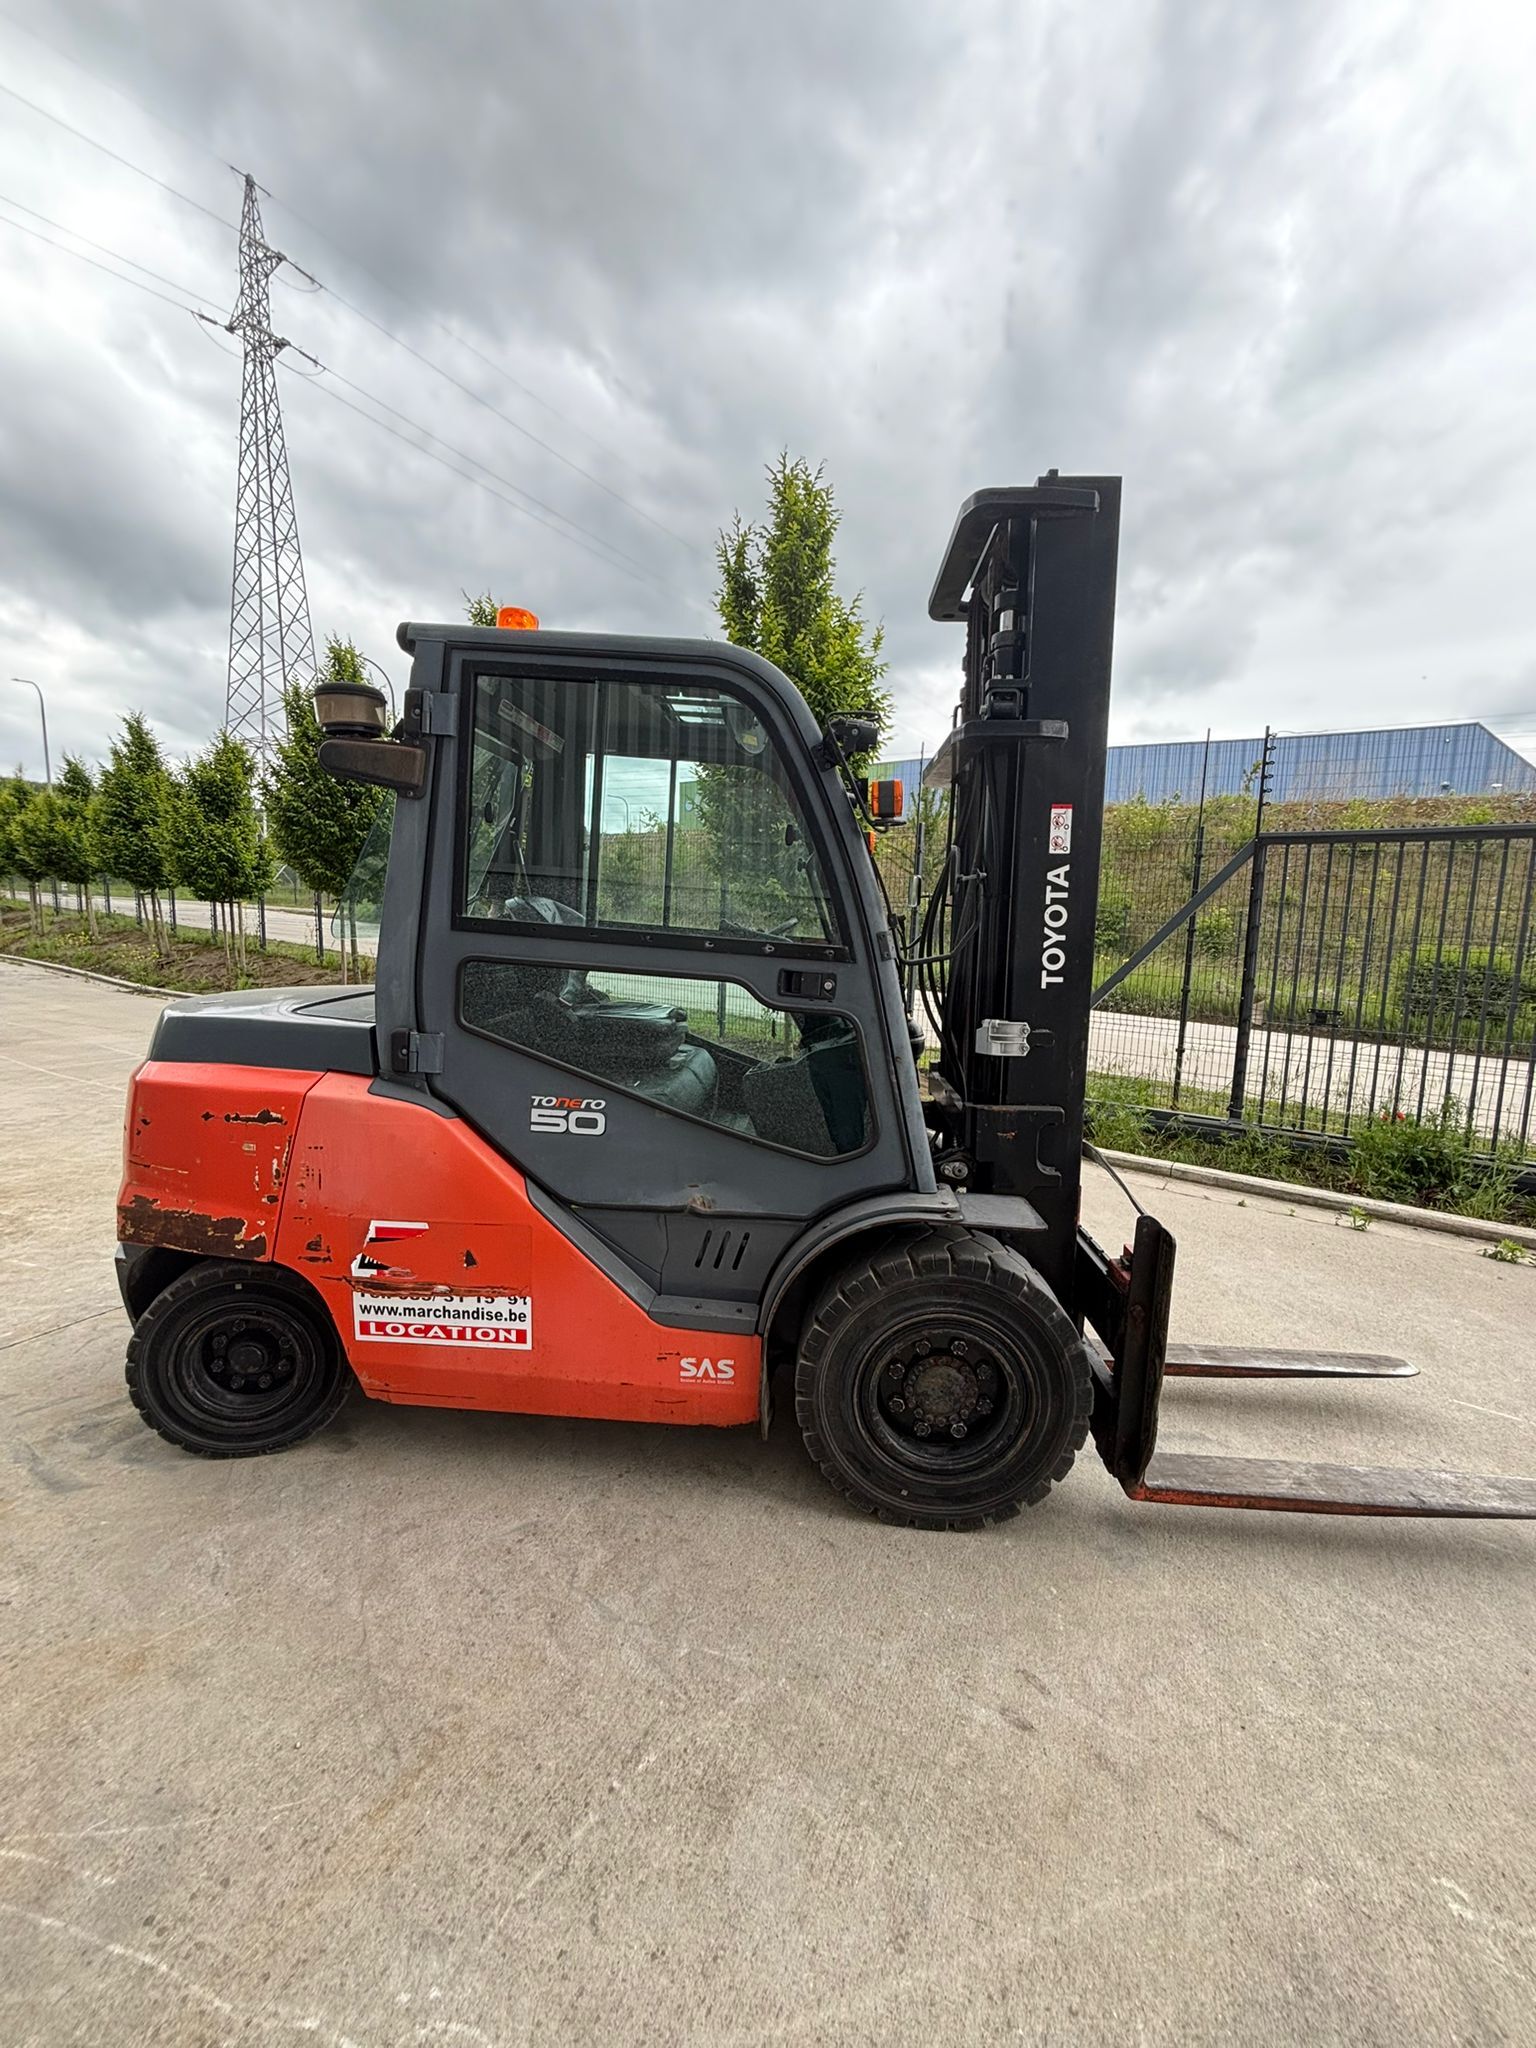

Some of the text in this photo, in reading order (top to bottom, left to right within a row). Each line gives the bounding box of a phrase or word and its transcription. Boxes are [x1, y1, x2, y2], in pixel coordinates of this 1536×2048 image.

[1041, 864, 1070, 989] TOYOTA
[530, 1108, 606, 1136] 50
[359, 1304, 527, 1323] www.marchandise.be
[369, 1322, 517, 1343] LOCATION
[679, 1357, 735, 1379] SAS
